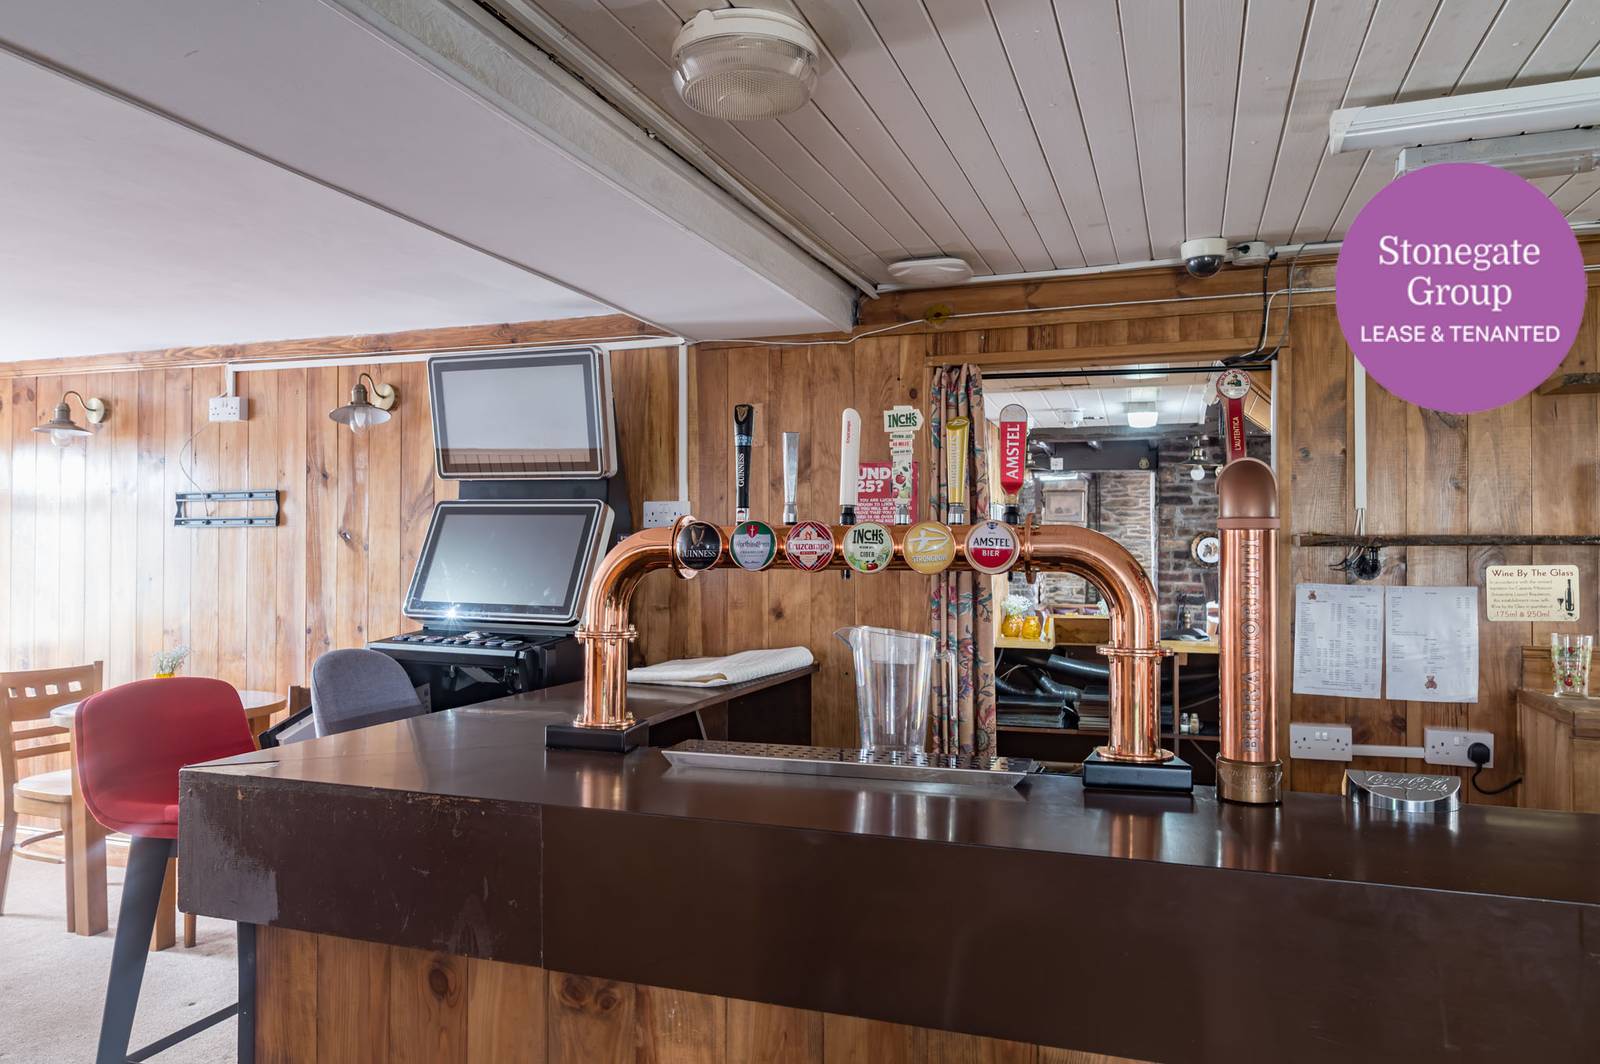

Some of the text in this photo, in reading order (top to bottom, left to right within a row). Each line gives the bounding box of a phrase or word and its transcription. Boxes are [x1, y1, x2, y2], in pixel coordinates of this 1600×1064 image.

[1006, 424, 1020, 480] AMSTEL
[857, 480, 884, 493] 25?
[852, 529, 884, 544] INCH'S
[973, 537, 1010, 547] AMSTEL
[788, 543, 830, 552] Cruzcampo
[982, 549, 1000, 557] BIER
[1492, 568, 1574, 577] Wine By The Glass
[1240, 538, 1260, 753] BIRRA MORETTI
